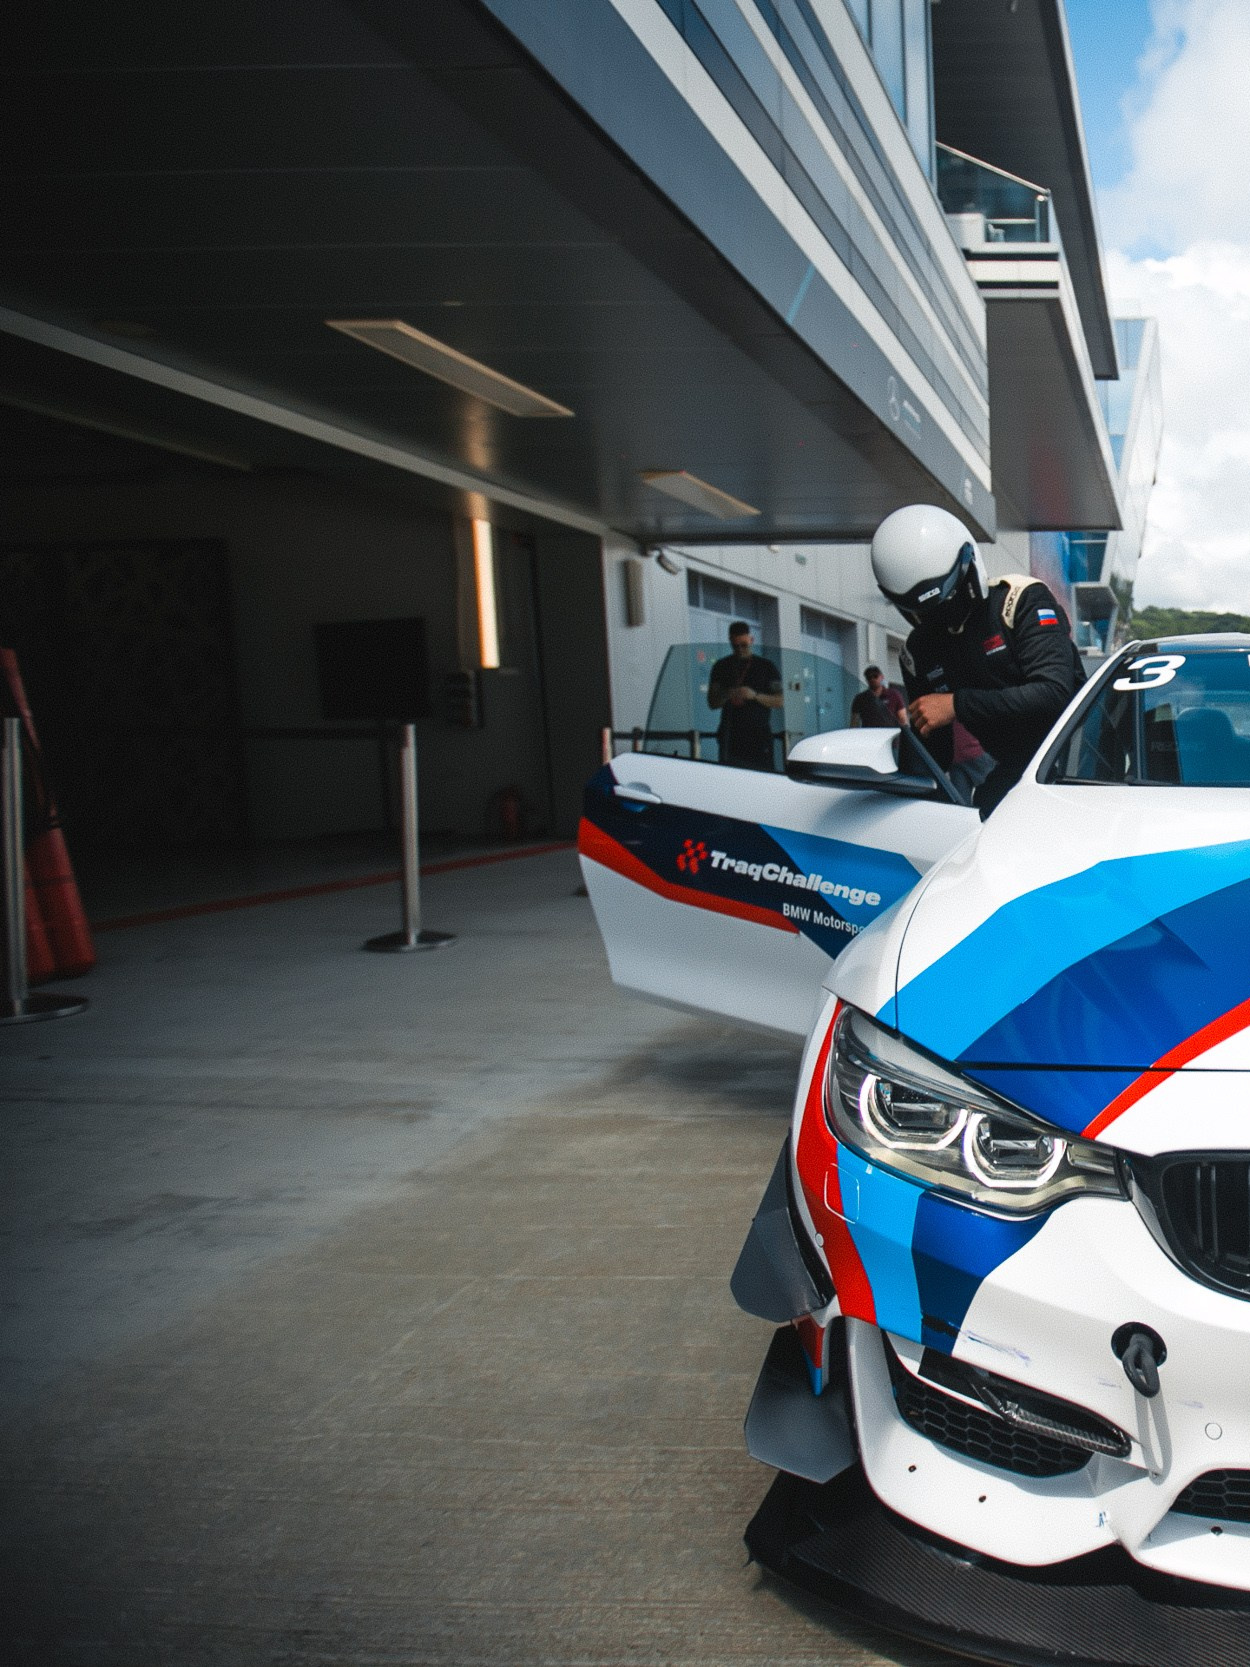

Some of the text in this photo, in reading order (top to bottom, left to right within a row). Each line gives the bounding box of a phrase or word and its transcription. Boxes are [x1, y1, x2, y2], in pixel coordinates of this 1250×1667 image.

[1112, 654, 1186, 691] 3
[710, 849, 882, 906] TraqChallenge
[782, 902, 811, 922] BMW
